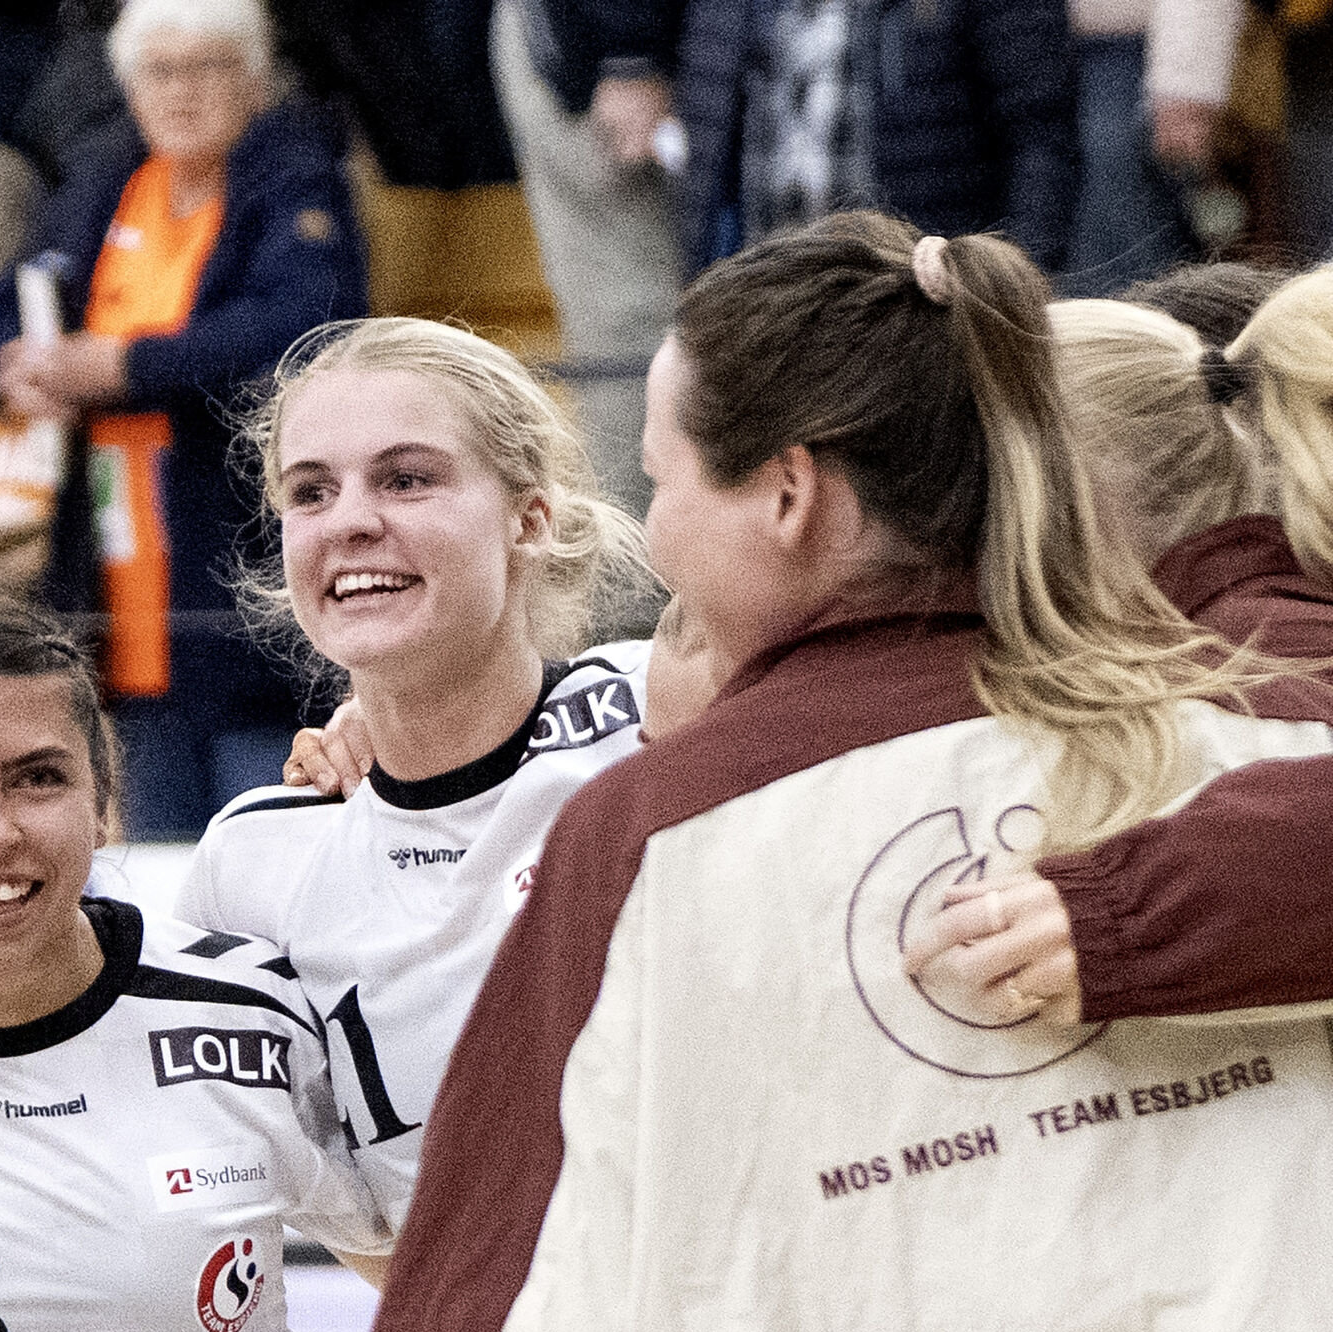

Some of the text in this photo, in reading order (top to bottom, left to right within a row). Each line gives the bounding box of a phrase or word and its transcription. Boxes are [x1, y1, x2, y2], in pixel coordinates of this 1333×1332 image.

[529, 682, 629, 746] OLK
[413, 848, 467, 866] hum
[160, 1034, 287, 1081] LOLK
[4, 1094, 87, 1118] hummel
[818, 1056, 1275, 1200] MOS MOSH TEAM ESBJERG
[196, 1162, 266, 1190] Sydbank
